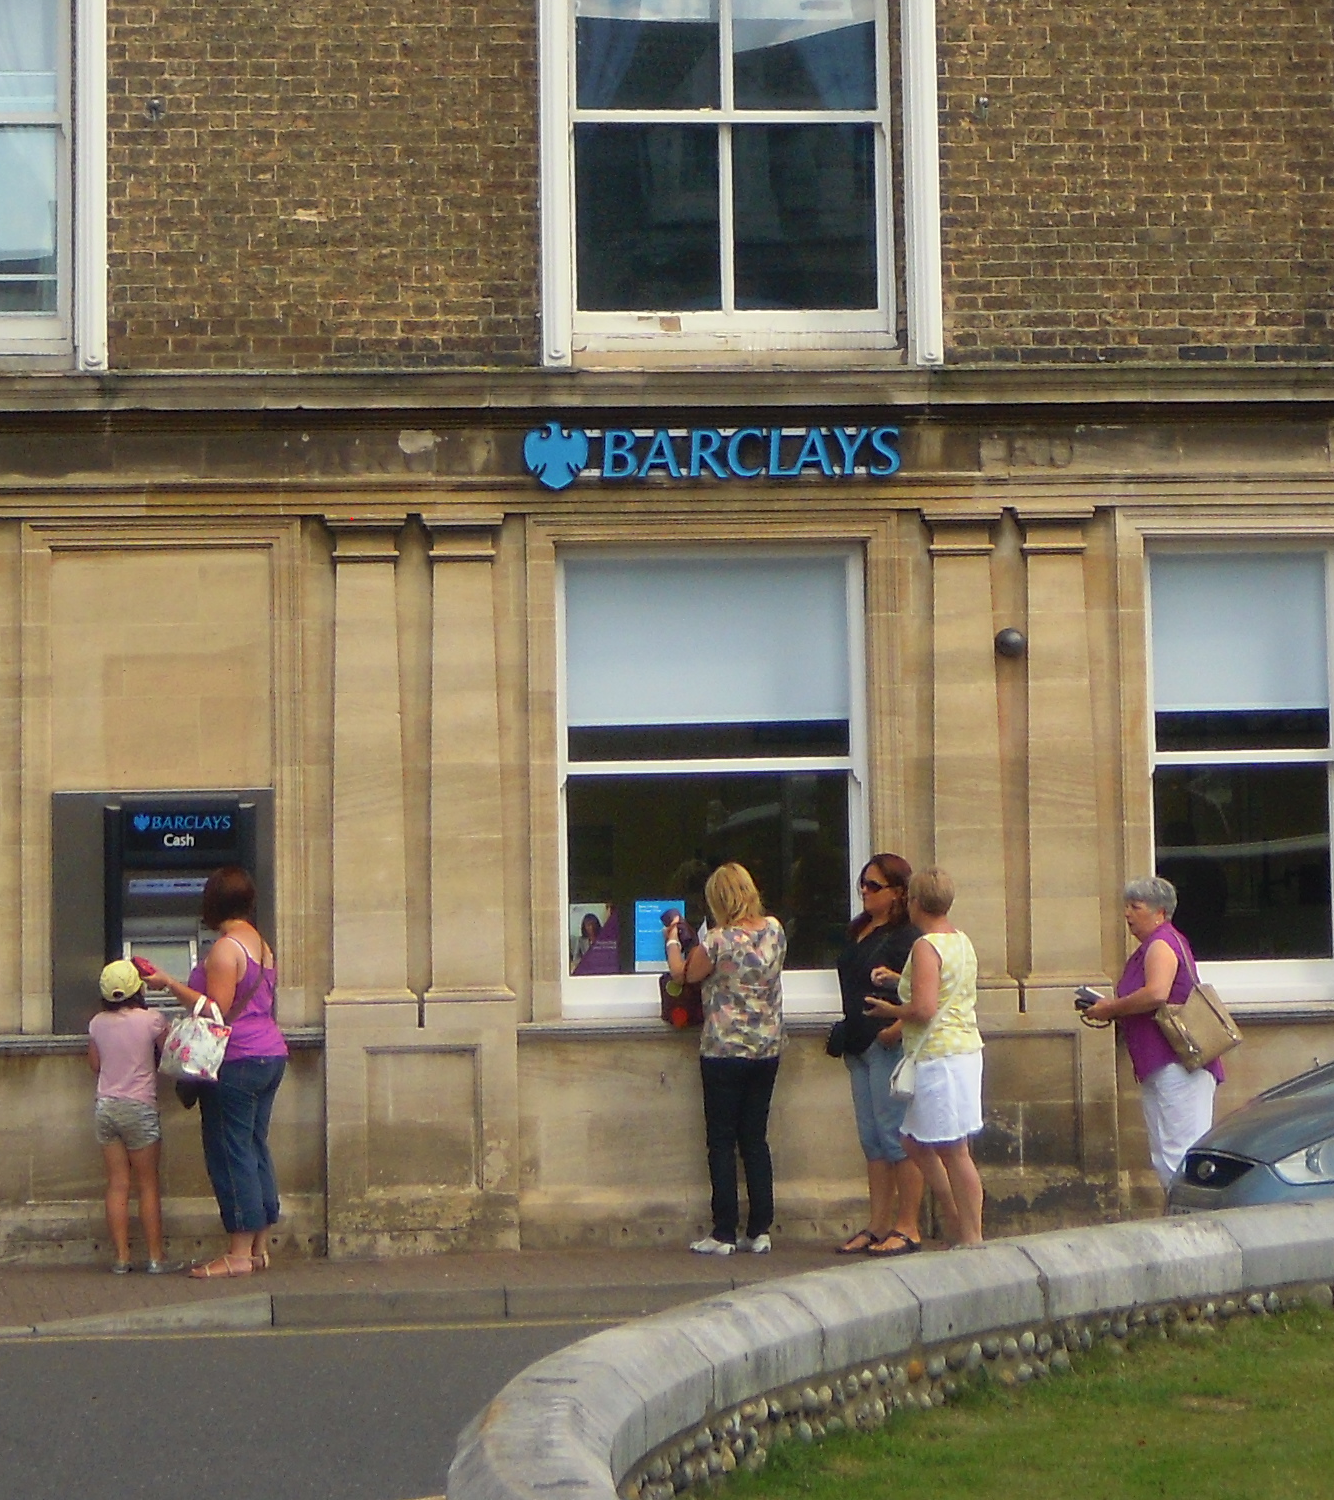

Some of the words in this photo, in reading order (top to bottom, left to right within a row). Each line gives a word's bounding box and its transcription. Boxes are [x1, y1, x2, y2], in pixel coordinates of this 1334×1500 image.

[602, 426, 901, 478] BARCLAYS
[152, 815, 231, 830] BARCLAYS
[163, 833, 195, 847] Cash
